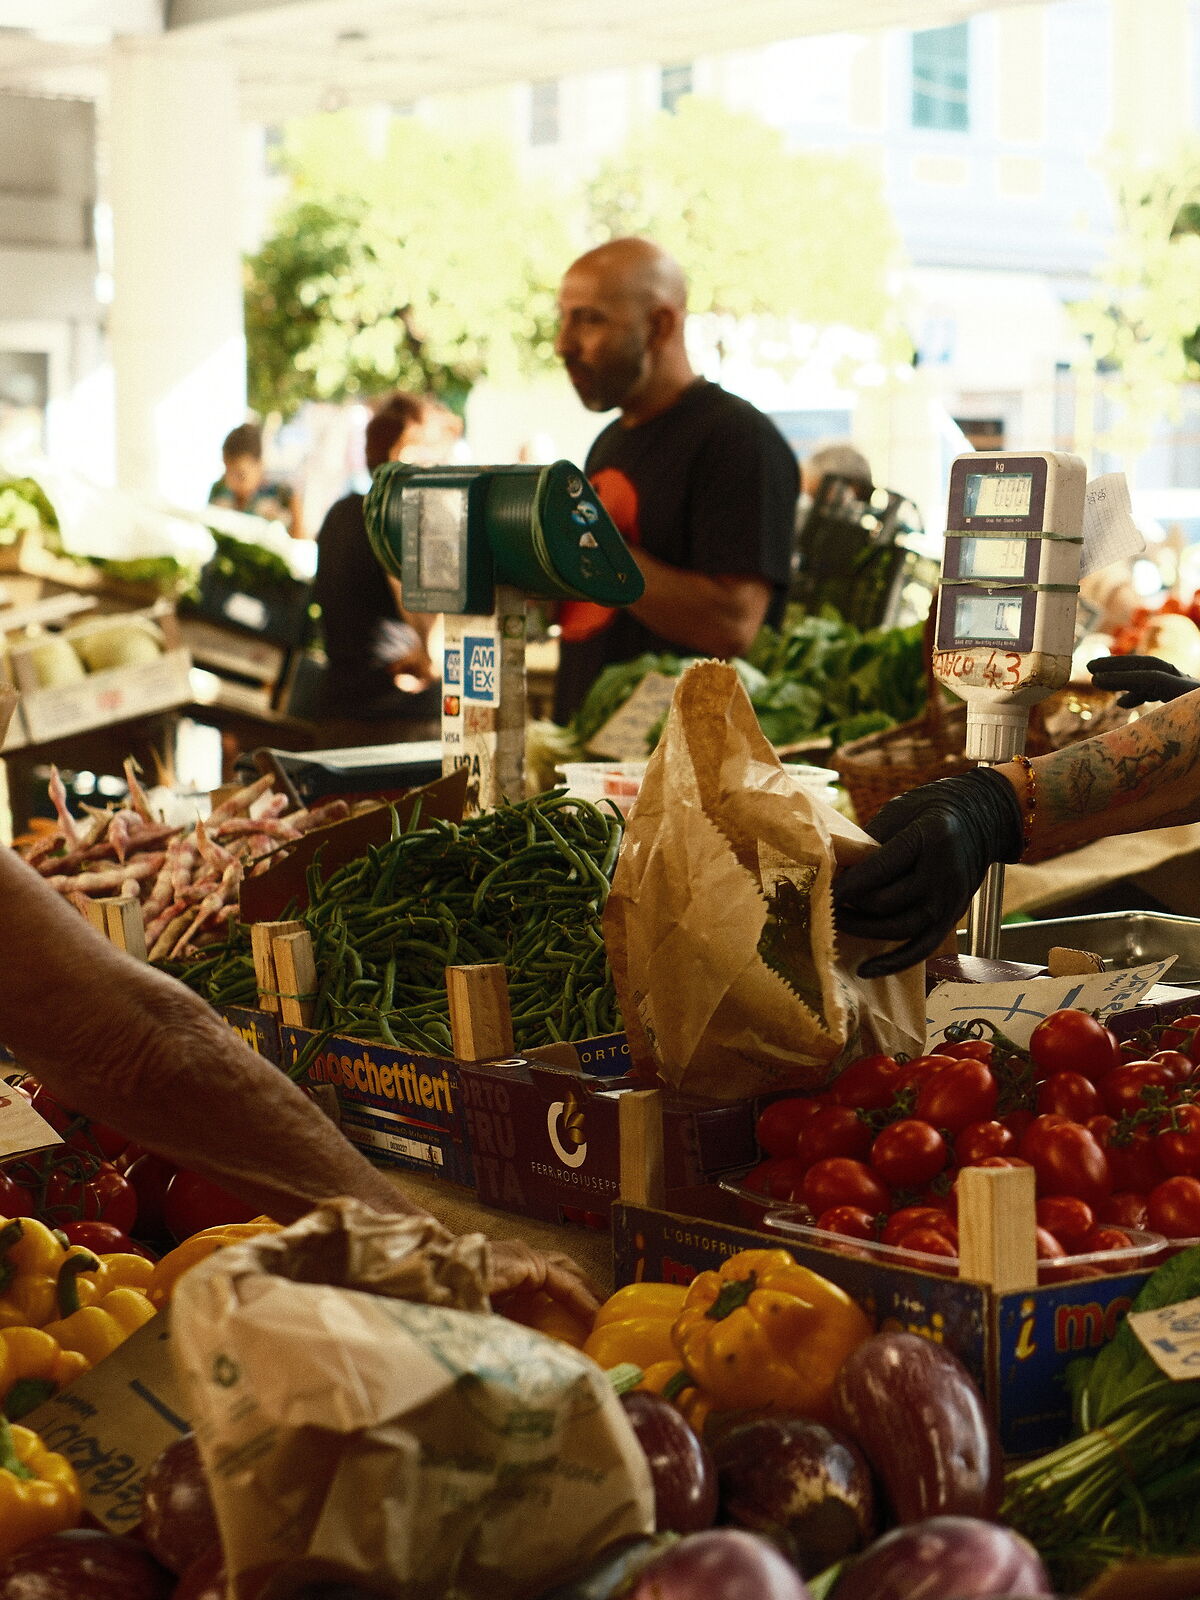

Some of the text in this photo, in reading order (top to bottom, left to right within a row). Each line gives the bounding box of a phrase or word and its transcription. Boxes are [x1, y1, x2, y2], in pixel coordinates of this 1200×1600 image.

[995, 461, 1005, 473] kg
[982, 650, 1023, 689] 43
[1015, 1296, 1038, 1361] i
